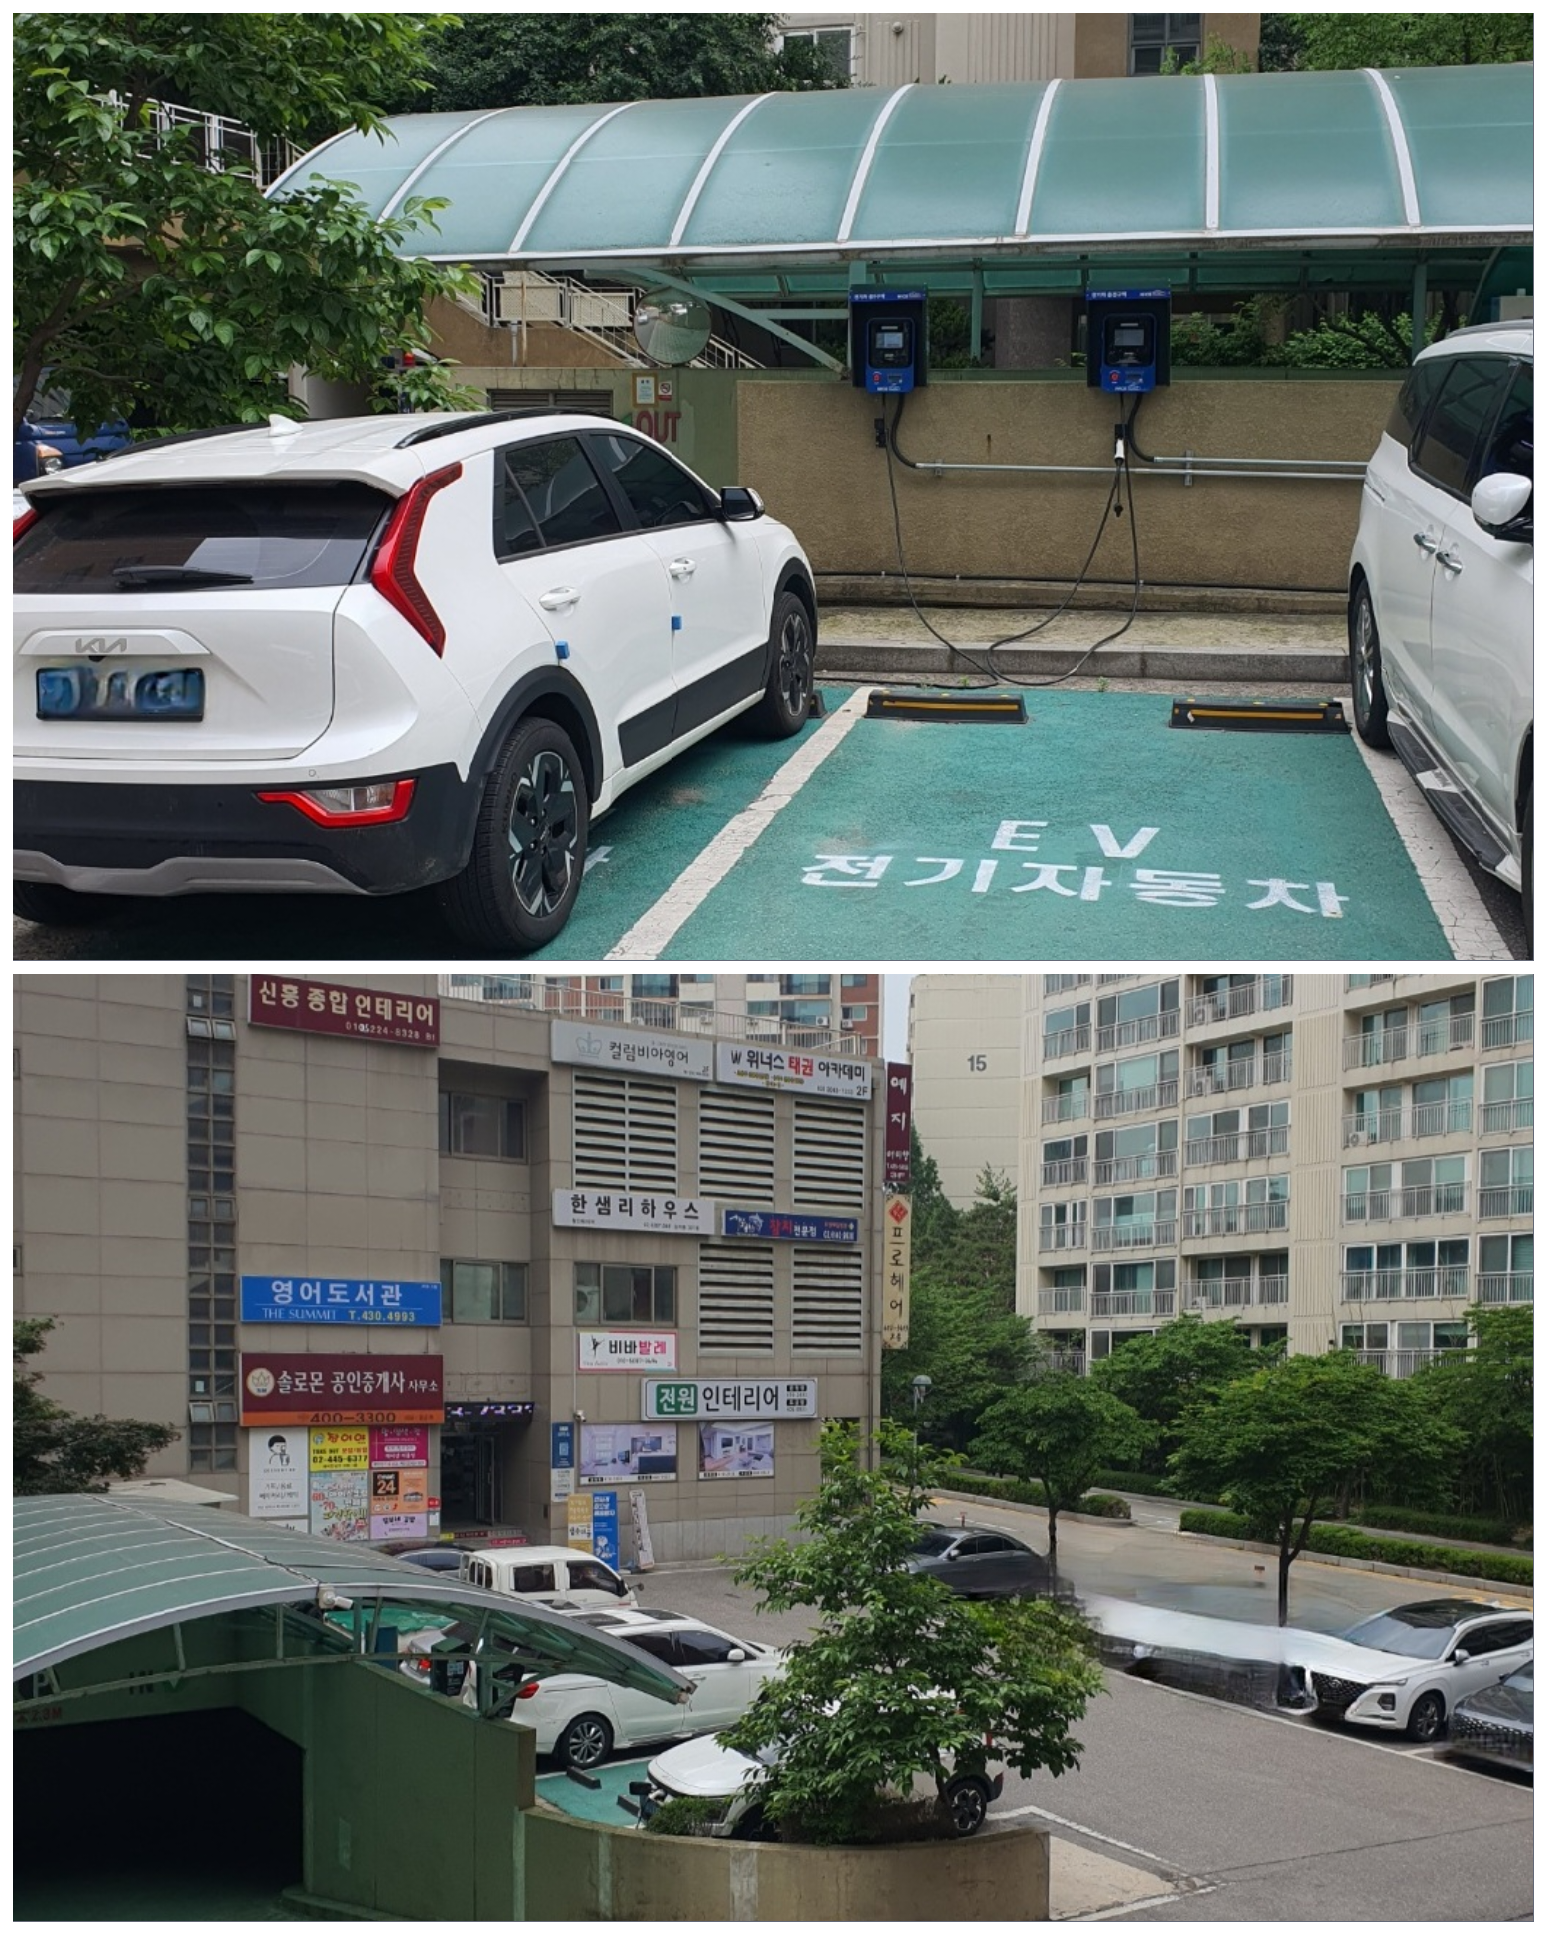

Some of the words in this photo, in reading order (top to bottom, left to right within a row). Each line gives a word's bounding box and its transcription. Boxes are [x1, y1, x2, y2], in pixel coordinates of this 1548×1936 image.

[636, 410, 682, 444] OUT
[800, 853, 1351, 919] 전기자동차
[259, 980, 300, 1009] 신흥
[307, 986, 349, 1016] 종합
[354, 993, 434, 1027] 인테리어
[608, 1041, 689, 1068] 컬럼비아영어
[746, 1049, 785, 1072] 위너스
[788, 1055, 814, 1077] 태권
[818, 1061, 866, 1082] 아카데미
[967, 1054, 987, 1072] 15
[856, 1085, 869, 1097] 2F
[888, 1226, 906, 1319] 프로헤어
[271, 1280, 403, 1306] 영어도서관
[262, 1307, 285, 1319] THE
[289, 1308, 338, 1321] SUMMIT
[348, 1310, 416, 1322] T.430.4993
[608, 1339, 667, 1355] 비바발레
[276, 1370, 325, 1395] 솔로몬
[330, 1370, 406, 1395] 공인중개사
[408, 1379, 439, 1393] 사무소
[659, 1386, 695, 1413] 전원
[702, 1385, 779, 1412] 인테리어
[309, 1411, 396, 1423] 400-3300
[377, 1480, 397, 1494] 24
